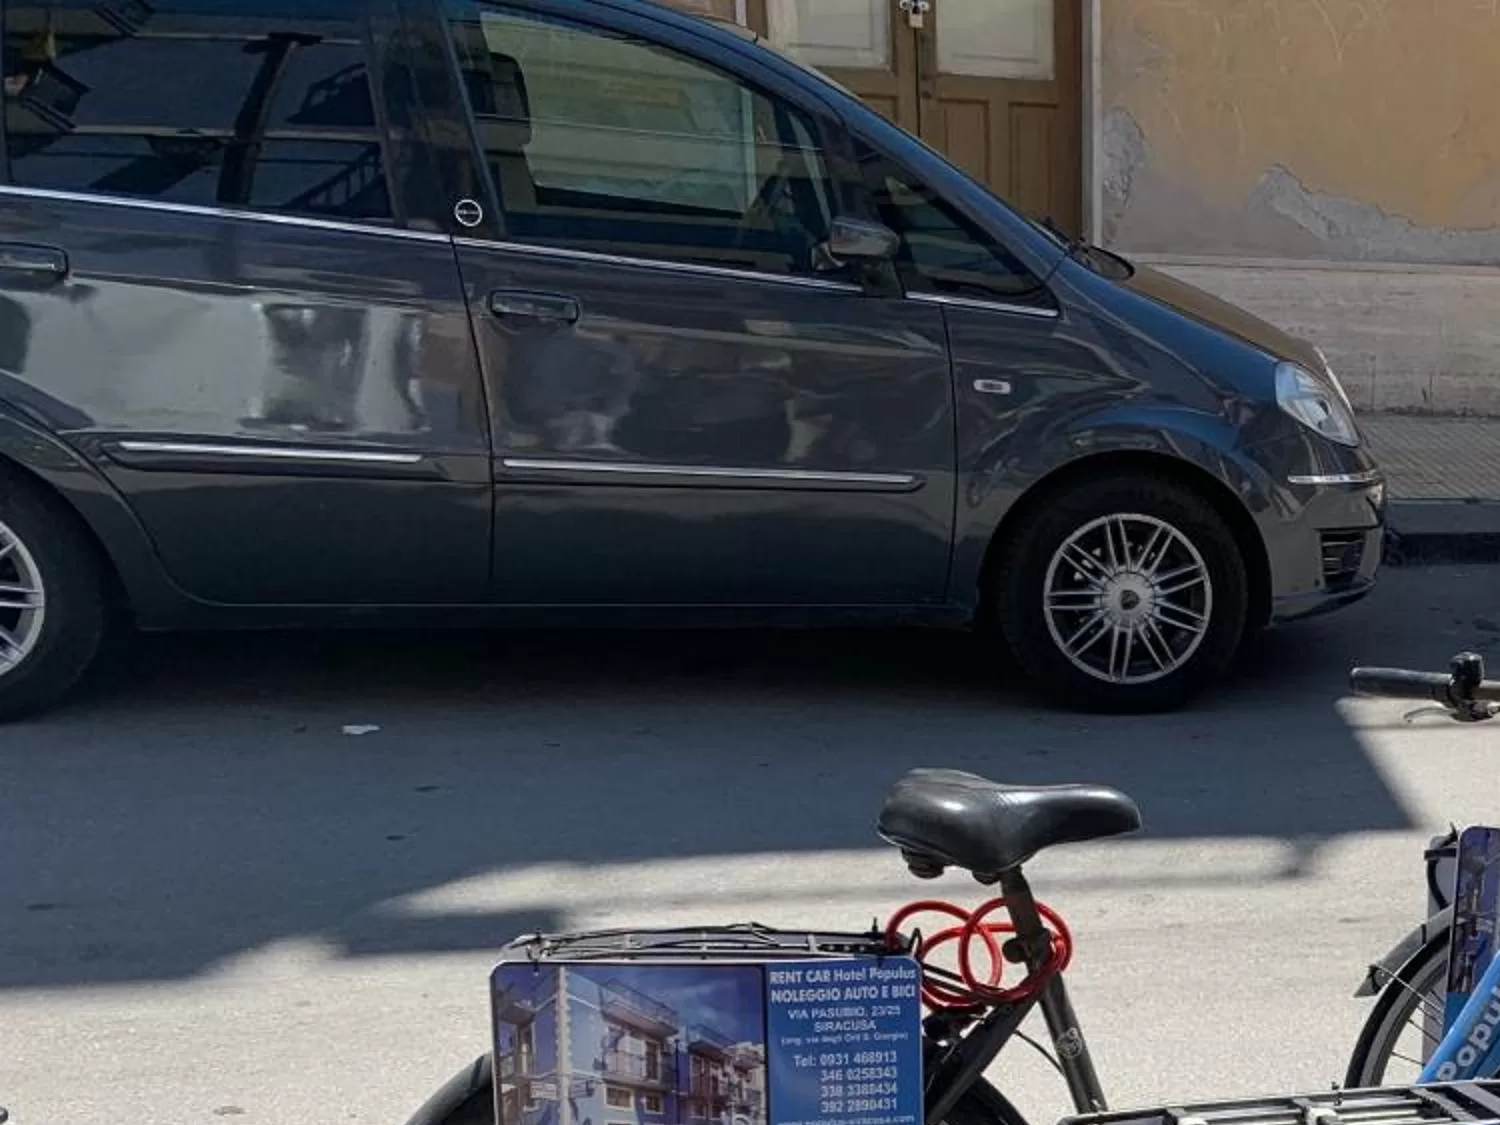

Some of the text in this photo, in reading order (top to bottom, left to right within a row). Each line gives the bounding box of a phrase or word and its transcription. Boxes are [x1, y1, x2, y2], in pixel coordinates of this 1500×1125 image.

[769, 966, 916, 985] RENT CAR Hotel Populus
[771, 984, 915, 1003] NOLEGGIO AUTO E BICI
[788, 1008, 809, 1020] VIA
[813, 1020, 877, 1033] SIRACUSA
[820, 1053, 849, 1067] 0931
[853, 1051, 897, 1066] 468913
[821, 1069, 843, 1082] 346
[821, 1100, 843, 1113] 392
